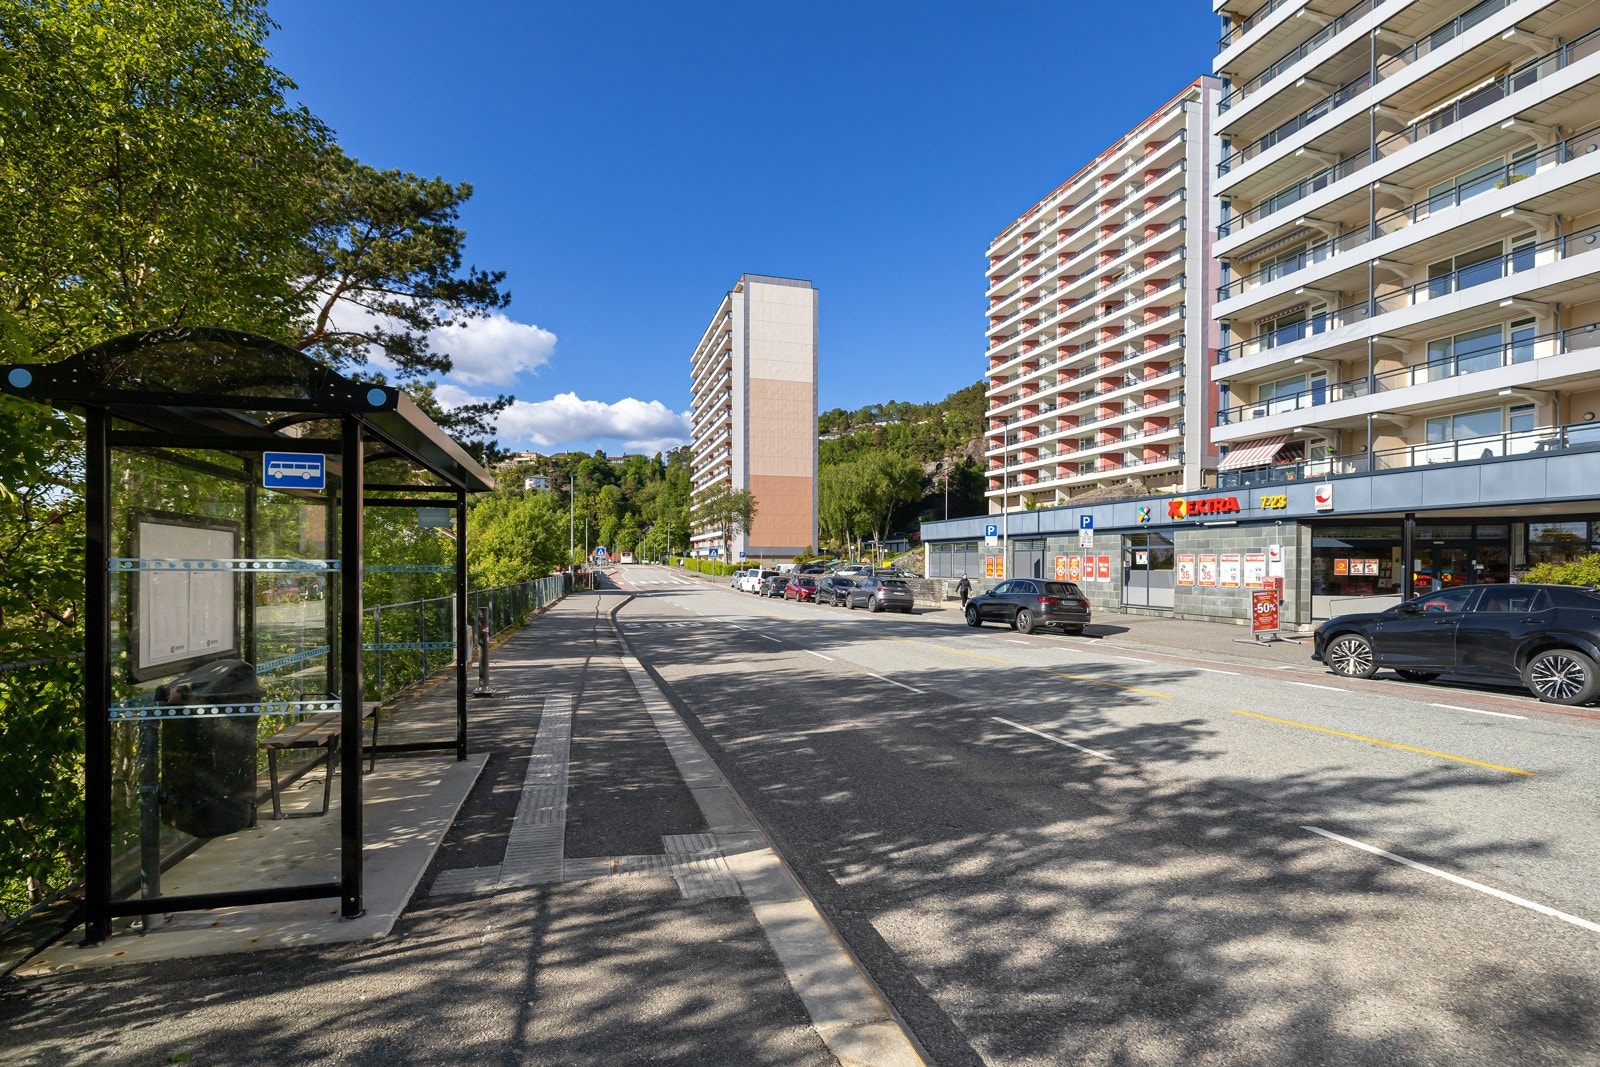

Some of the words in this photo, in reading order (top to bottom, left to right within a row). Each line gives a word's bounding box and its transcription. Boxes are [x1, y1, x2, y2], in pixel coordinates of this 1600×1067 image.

[1186, 496, 1241, 515] EXTRA
[1260, 494, 1287, 509] 7-23
[1083, 516, 1091, 528] P
[987, 525, 995, 536] P
[1181, 570, 1190, 579] 35
[1202, 571, 1211, 580] 35
[1254, 602, 1276, 614] -50%
